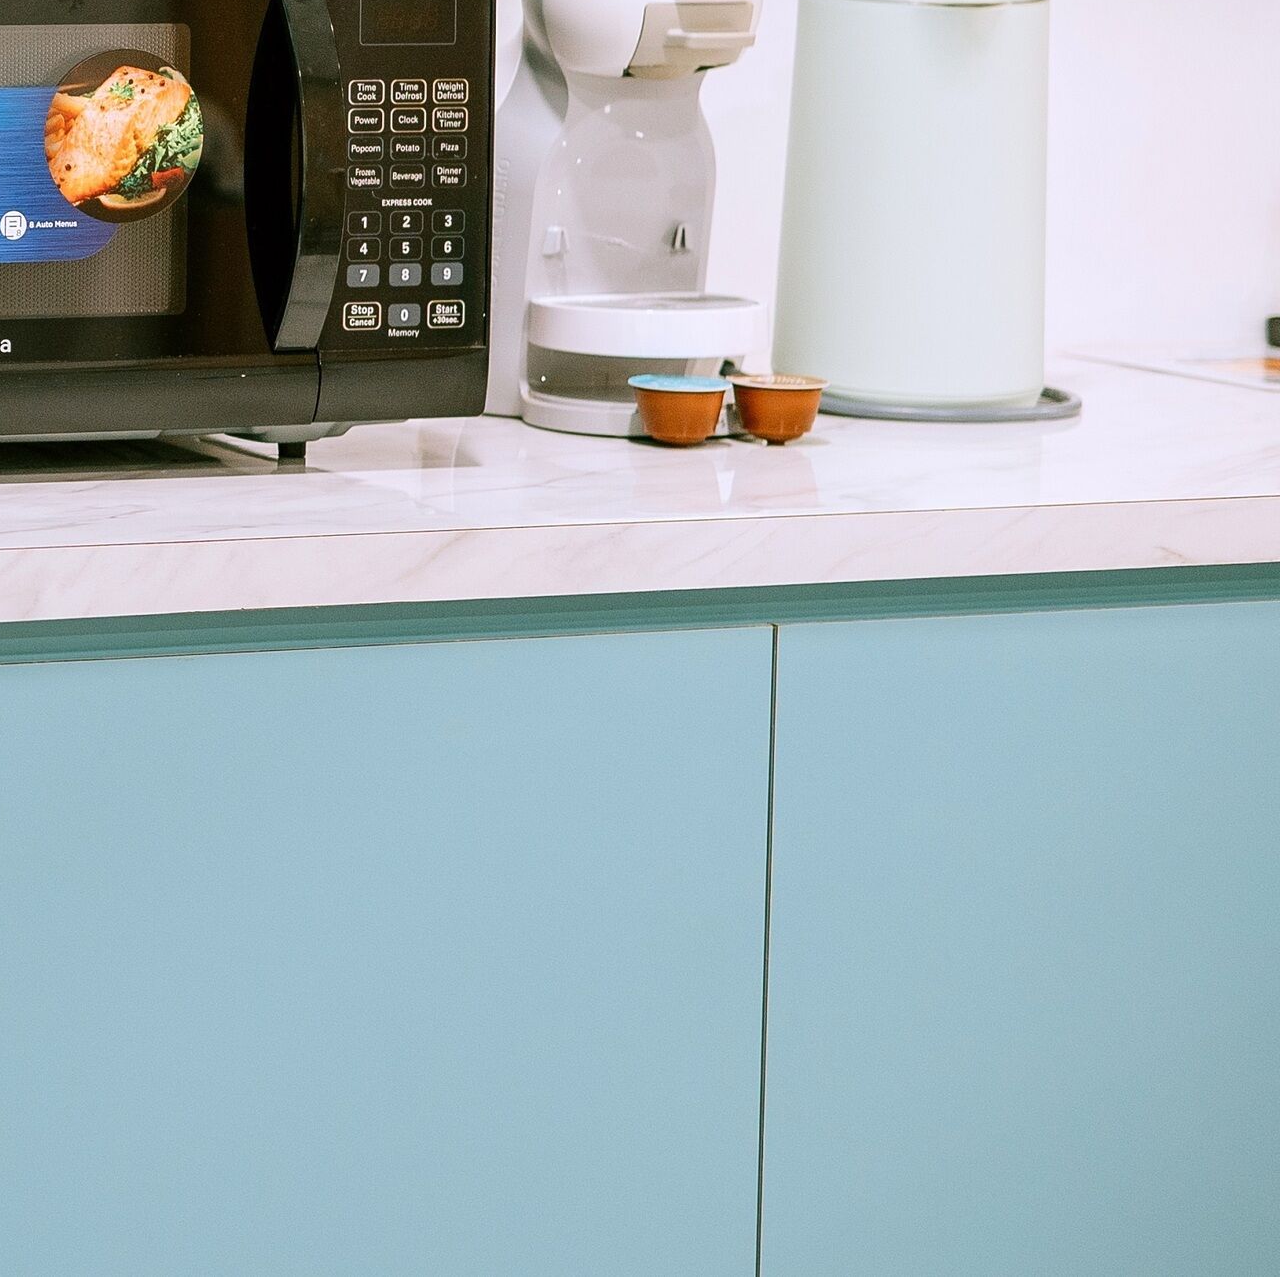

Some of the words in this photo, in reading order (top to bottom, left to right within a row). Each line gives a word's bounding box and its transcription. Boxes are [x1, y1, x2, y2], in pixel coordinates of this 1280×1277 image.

[357, 83, 376, 91] Time
[400, 83, 418, 91] Time
[437, 82, 464, 92] Weight
[357, 92, 376, 100] Cook
[395, 91, 422, 100] Defrost
[437, 91, 464, 99] Defrost
[437, 110, 464, 119] Kitchen
[354, 116, 378, 124] Power
[398, 115, 418, 124] Clock
[440, 119, 461, 128] Timer
[351, 144, 381, 154] Popcorn
[396, 143, 420, 152] Potato
[440, 143, 459, 151] Pizza
[355, 168, 375, 176] Frozen
[437, 167, 462, 175] Dinner
[392, 172, 422, 181] Beverage
[440, 175, 459, 184] Plate
[350, 177, 380, 187] Vegetable
[413, 198, 433, 206] COOK
[361, 216, 368, 229] 1
[402, 215, 411, 228] 2
[444, 214, 453, 227] 3
[359, 242, 368, 255] 4
[402, 242, 410, 254] 5
[443, 240, 452, 253] 6
[359, 269, 368, 282] 7
[401, 268, 410, 281] 8
[443, 267, 452, 280] 9
[351, 304, 374, 316] Stop
[435, 304, 457, 314] Start
[400, 308, 409, 322] 0
[349, 318, 375, 326] Cancel
[432, 316, 459, 324] +30sec.
[388, 328, 419, 338] Memory
